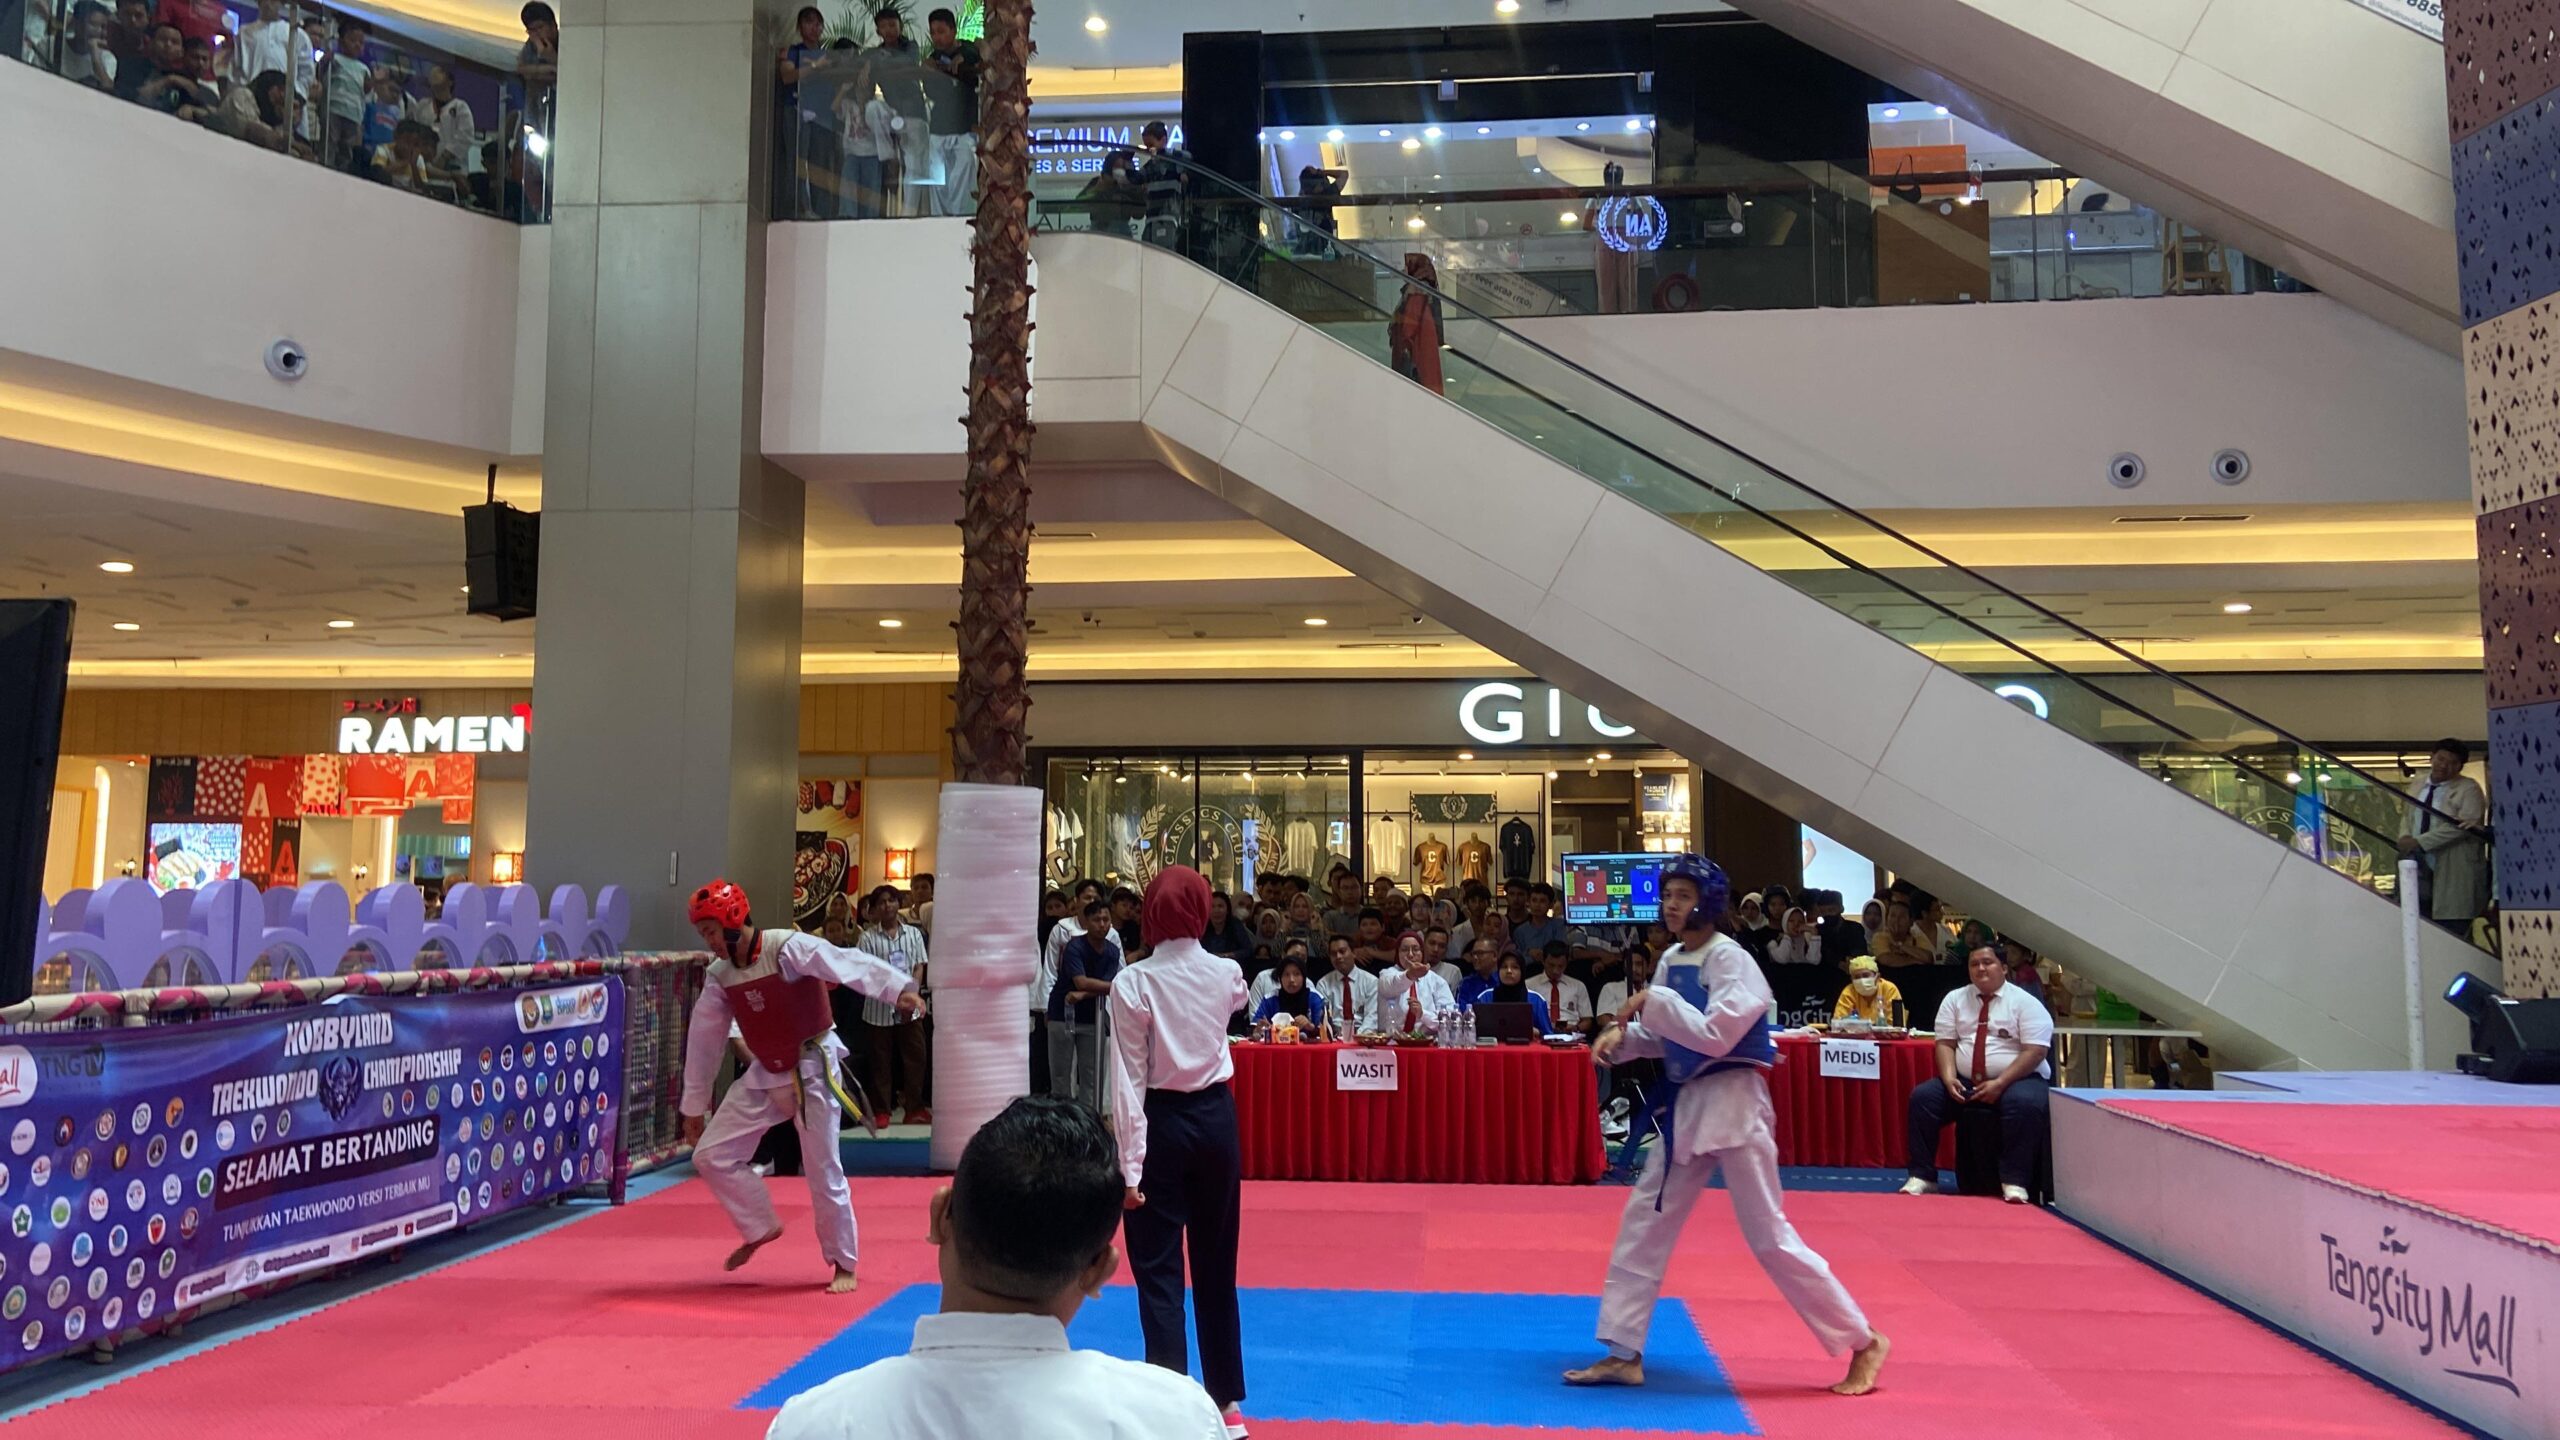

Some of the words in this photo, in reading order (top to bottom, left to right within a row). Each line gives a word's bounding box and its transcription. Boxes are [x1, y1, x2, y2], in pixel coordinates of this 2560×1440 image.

[1056, 160, 1067, 172] &
[338, 716, 525, 753] RAMEN
[1164, 808, 1222, 866] CLASSCS
[1586, 881, 1595, 894] 8
[1643, 880, 1653, 893] 0
[284, 1012, 394, 1057] HOBBYLAND
[1340, 1063, 1395, 1078] WASIT
[1824, 1050, 1876, 1066] MEDIS
[211, 1068, 319, 1117] TAEKWONDO
[363, 1048, 462, 1090] CHAMPIONSHIP
[223, 1144, 316, 1193] SELAMAT
[320, 1119, 436, 1169] BERTANDING
[284, 1195, 355, 1224] TAEKWONDO
[358, 1191, 384, 1208] VERSI
[384, 1181, 417, 1201] TERBAIK
[418, 1175, 431, 1191] MU
[2440, 1282, 2516, 1378] Mall
